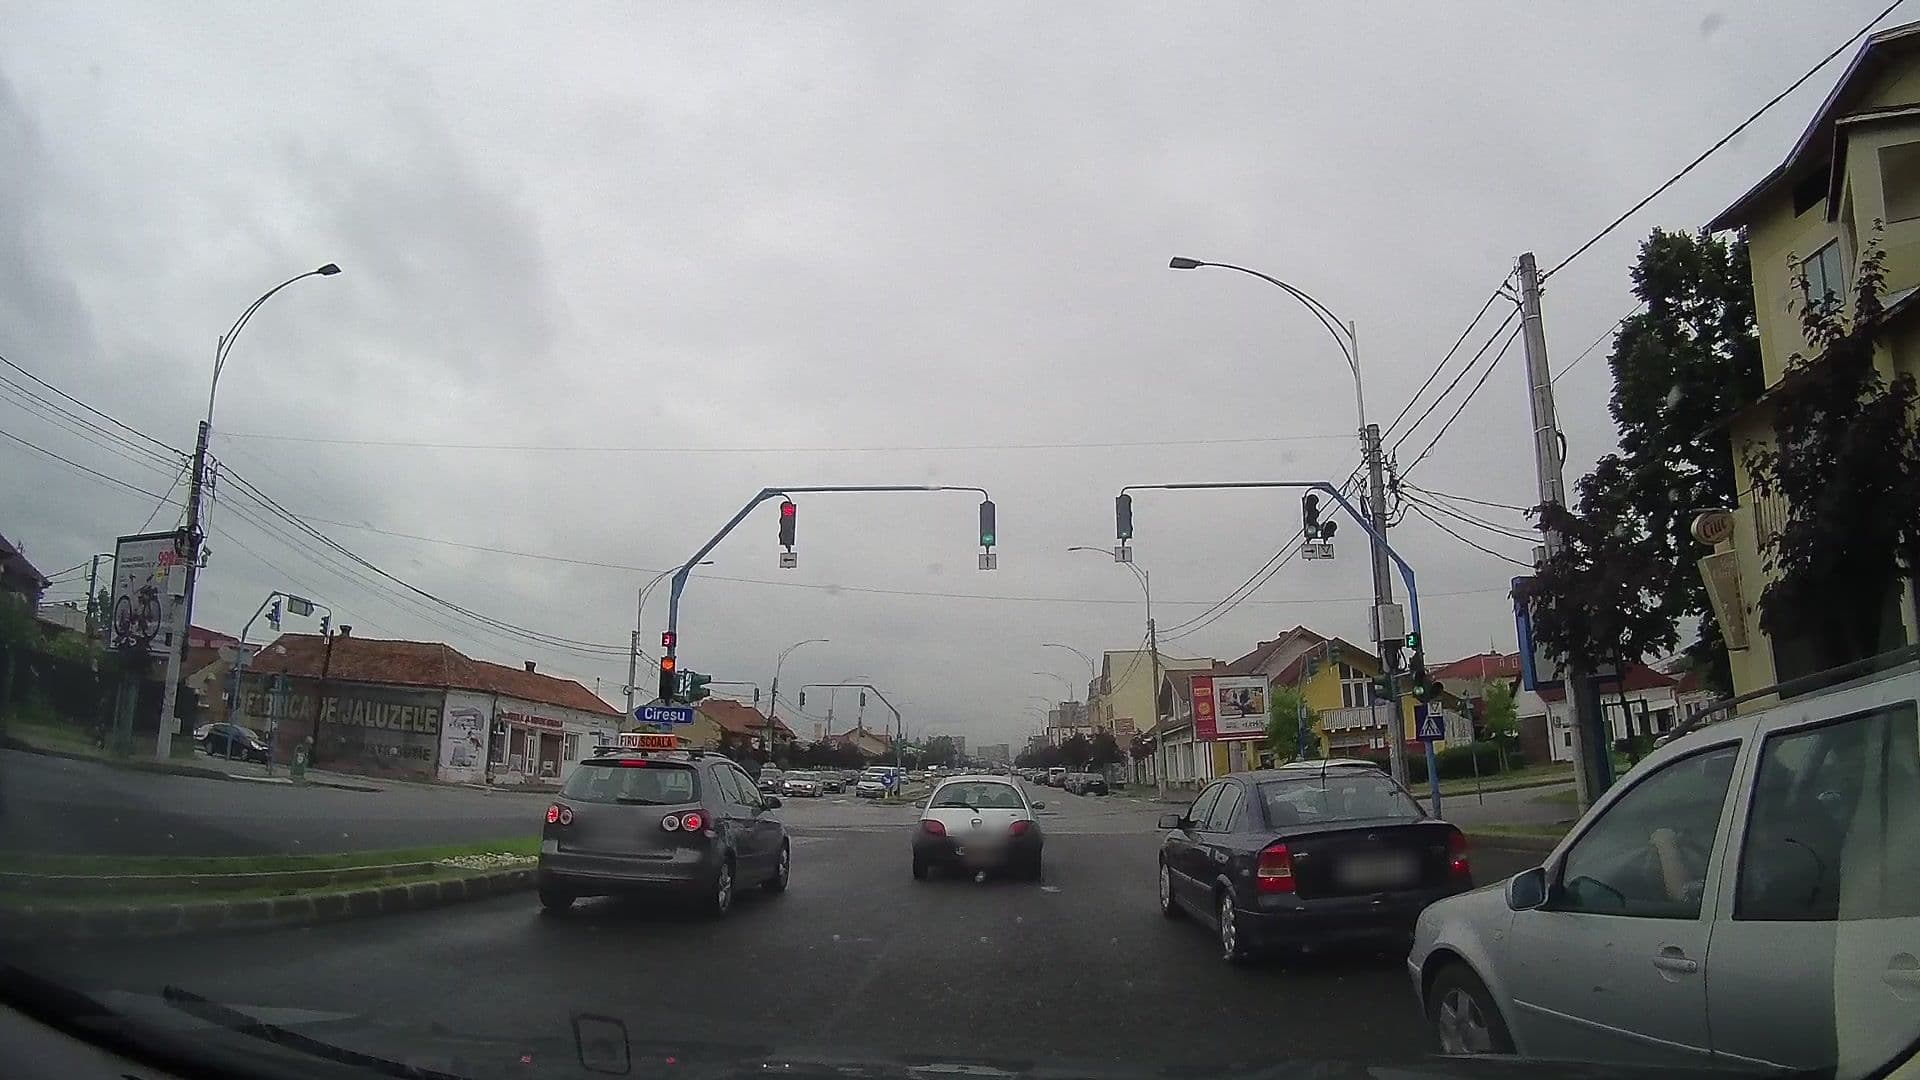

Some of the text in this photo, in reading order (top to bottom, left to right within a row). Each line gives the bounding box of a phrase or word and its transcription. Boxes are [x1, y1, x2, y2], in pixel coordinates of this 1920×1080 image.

[1408, 635, 1415, 646] 2
[342, 699, 438, 734] JALUZELE
[644, 707, 686, 721] Ciresu
